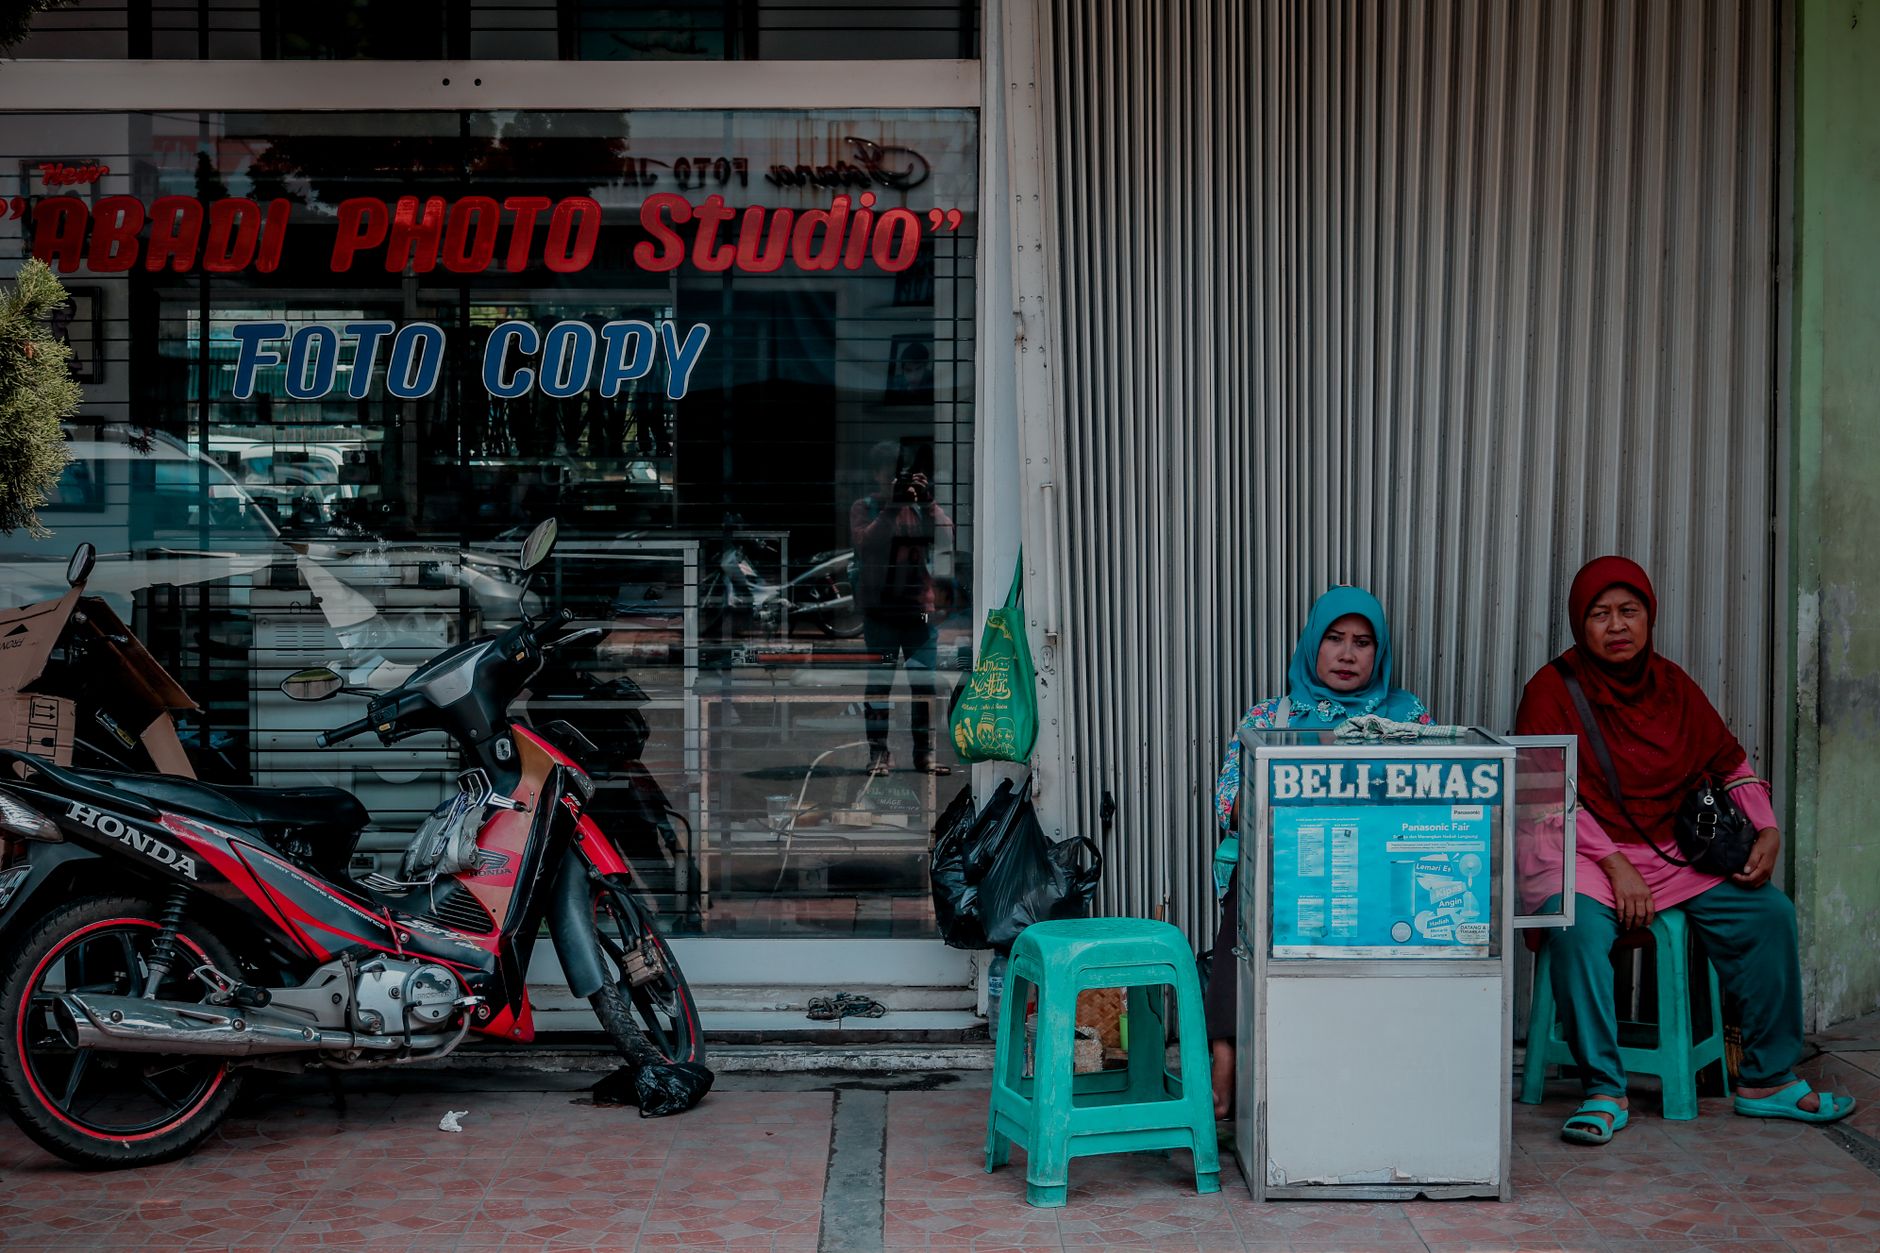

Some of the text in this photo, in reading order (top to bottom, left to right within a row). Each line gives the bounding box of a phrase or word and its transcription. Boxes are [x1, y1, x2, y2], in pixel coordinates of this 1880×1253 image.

[39, 162, 110, 186] New
[330, 195, 603, 274] PHOTO
[231, 319, 712, 401] FOTO COPY
[1273, 763, 1499, 799] BELI EMAS
[1401, 822, 1471, 832] Panasonic Fair
[65, 800, 199, 881] HONDA
[468, 868, 513, 878] HONDA
[1416, 863, 1441, 872] Lemari
[1438, 897, 1463, 908] Angin
